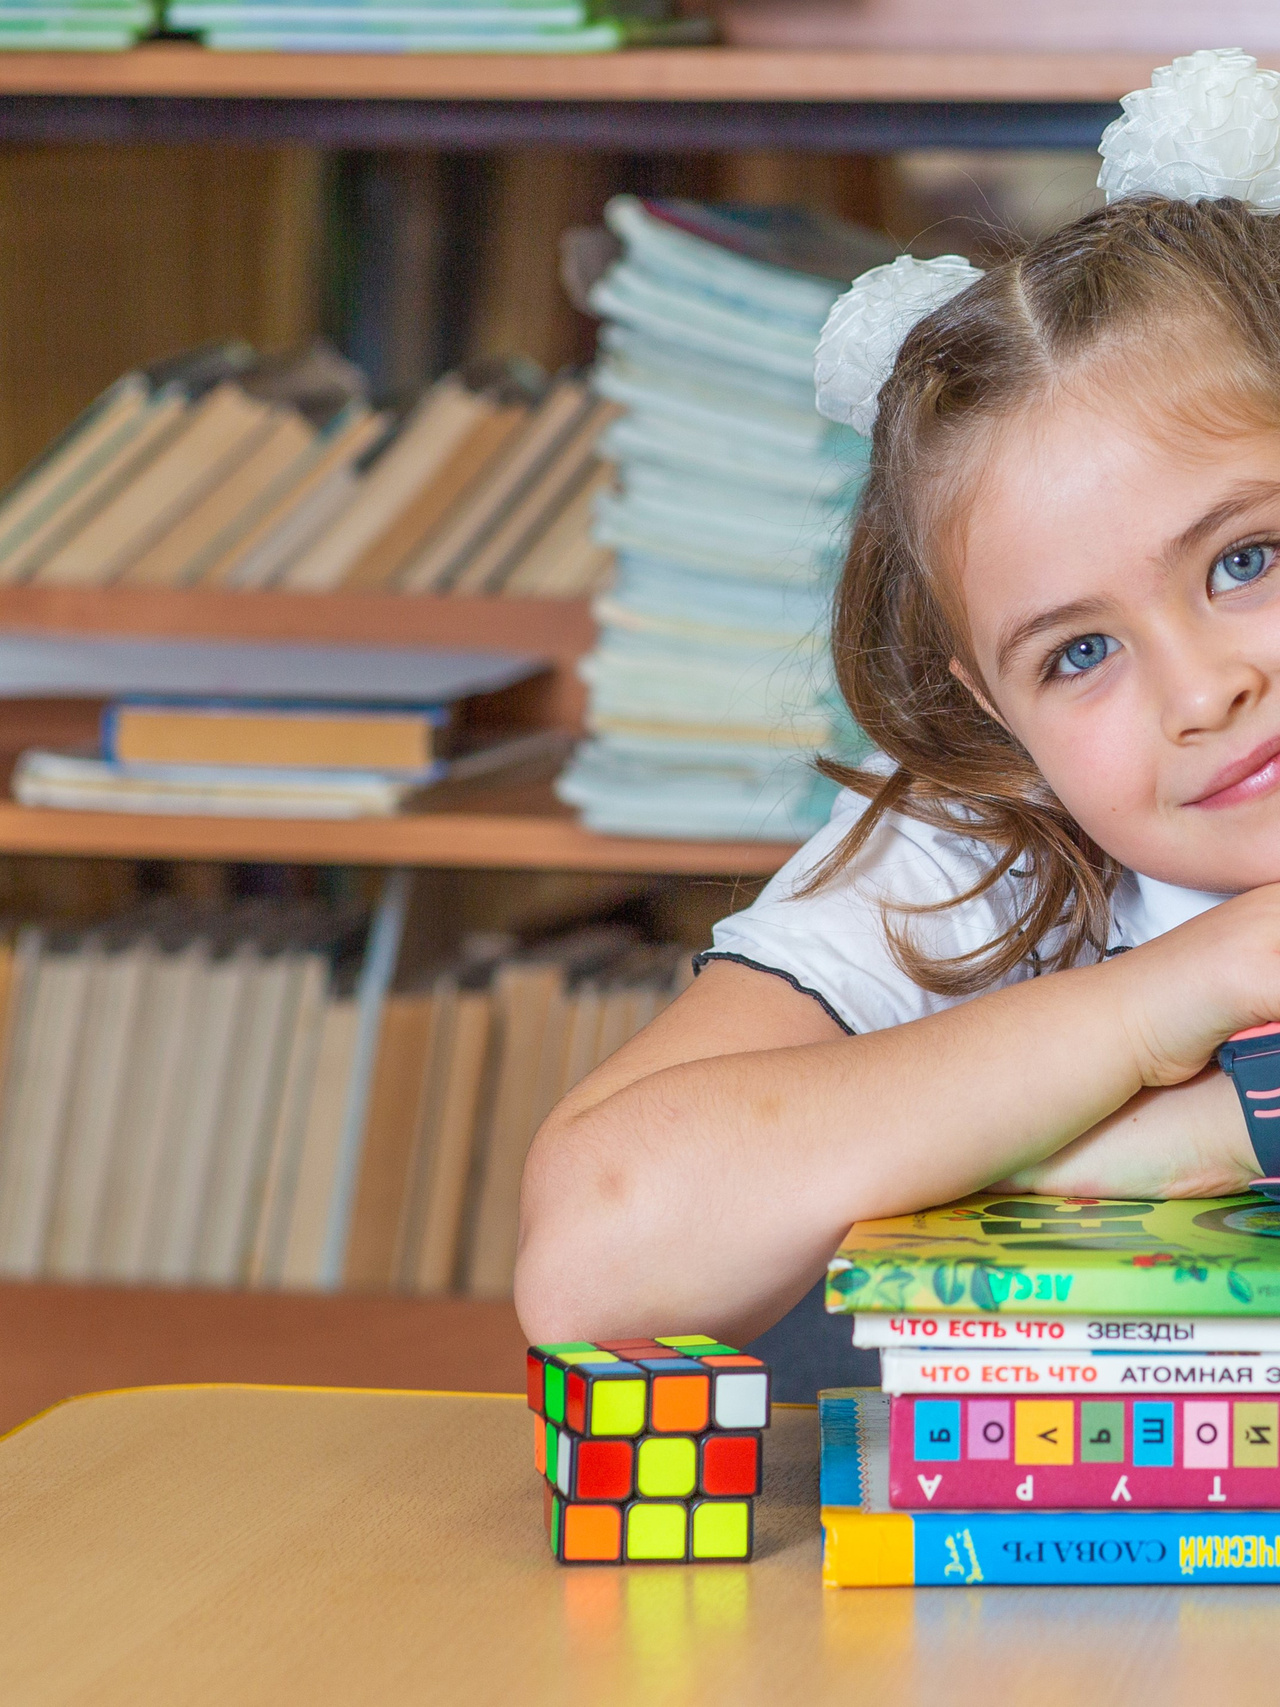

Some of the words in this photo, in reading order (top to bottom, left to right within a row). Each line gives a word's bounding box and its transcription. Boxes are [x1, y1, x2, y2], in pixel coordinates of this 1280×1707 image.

[977, 1195, 1190, 1251] ЛЕС
[987, 1273, 1073, 1301] ЛЕСА
[889, 1317, 938, 1337] ЧТО
[948, 1318, 1007, 1338] ЕСТЬ
[1015, 1320, 1065, 1340] ЧТО
[1087, 1321, 1195, 1342] ЗВЕЗДЫ
[920, 1365, 970, 1383] ЧТО
[981, 1365, 1040, 1383] ЕСТЬ
[1048, 1365, 1098, 1383] ЧТО
[1121, 1366, 1253, 1383] АТОМНАЯ
[1002, 1541, 1167, 1564] СЛОВАРЬ
